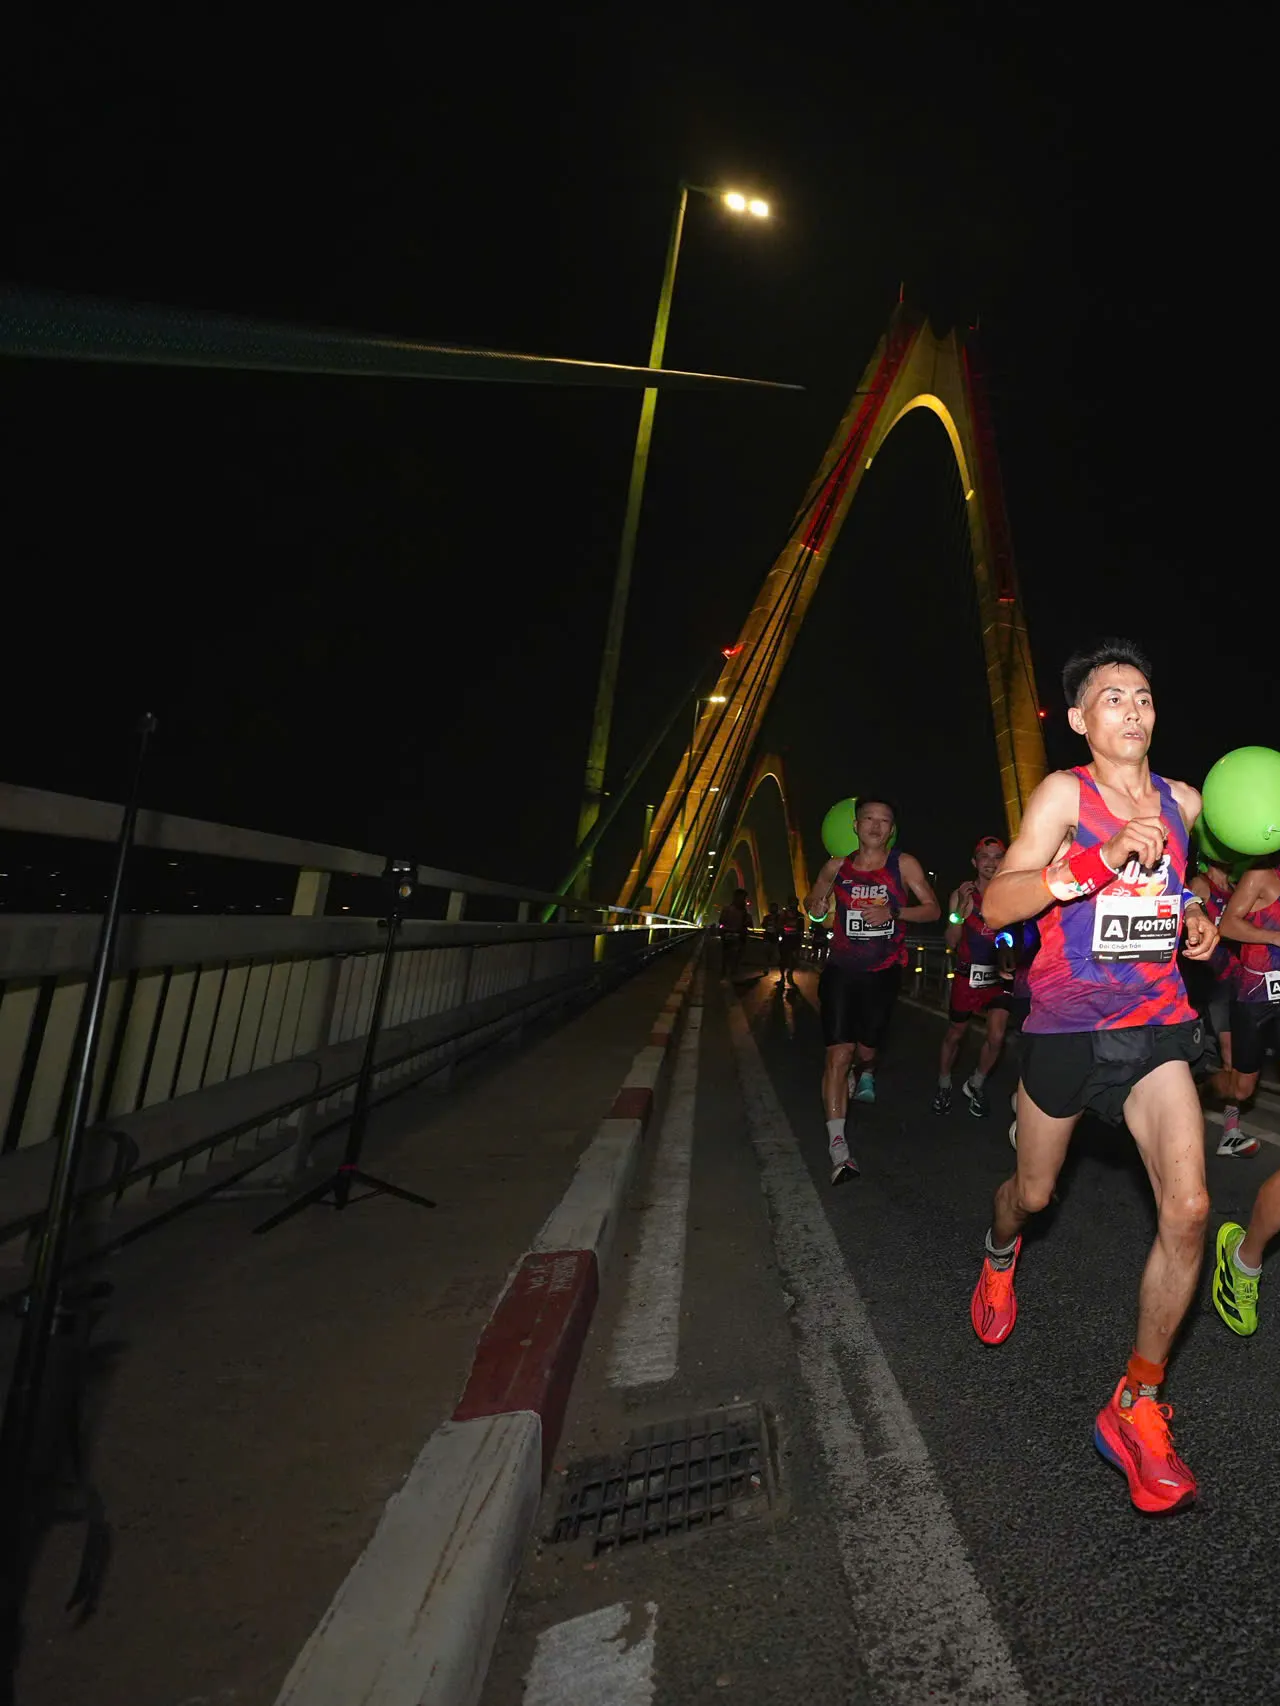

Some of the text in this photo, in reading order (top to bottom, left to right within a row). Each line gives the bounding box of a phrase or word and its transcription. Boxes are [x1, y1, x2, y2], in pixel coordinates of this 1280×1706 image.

[851, 885, 888, 899] SUB3
[852, 921, 860, 930] B
[1104, 918, 1175, 938] A 401761
